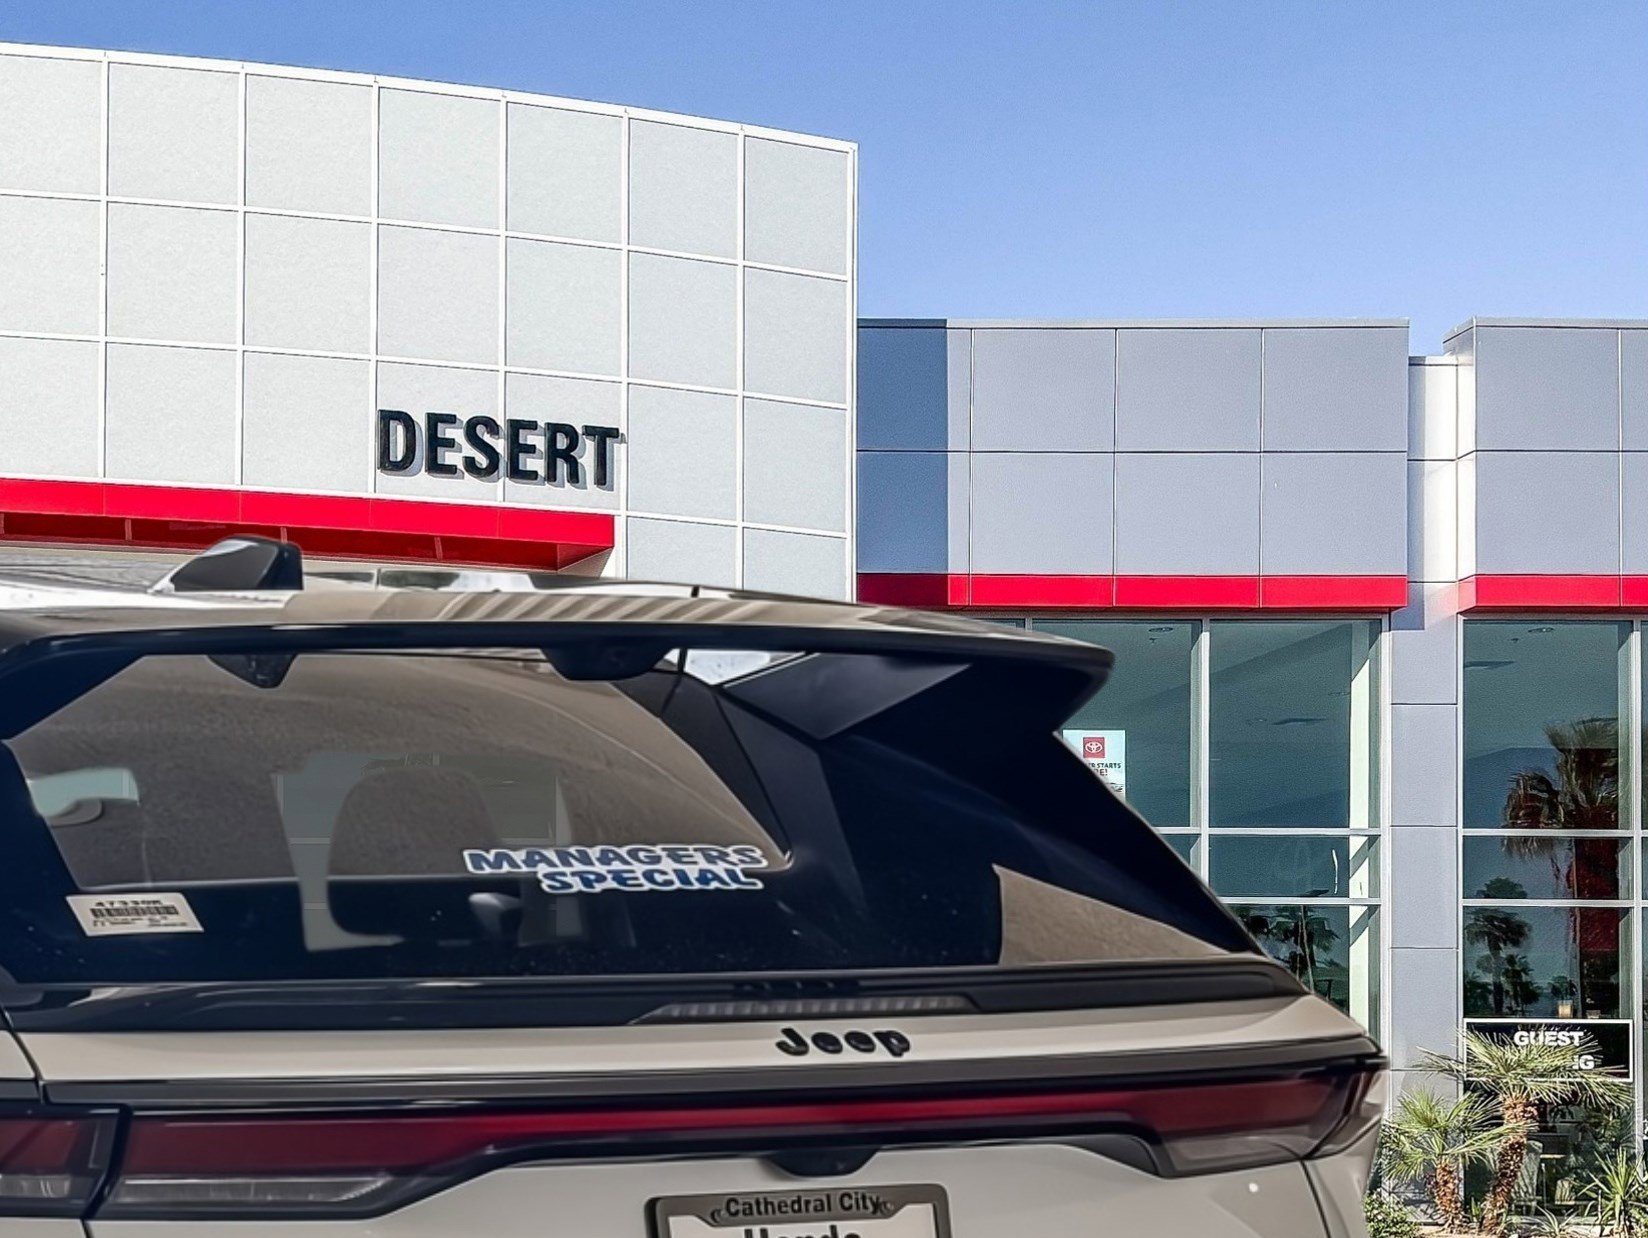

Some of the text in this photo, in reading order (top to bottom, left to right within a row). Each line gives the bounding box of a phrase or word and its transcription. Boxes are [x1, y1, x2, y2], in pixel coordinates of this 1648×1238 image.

[377, 409, 620, 486] DESERT
[464, 845, 767, 872] MANAGERS
[539, 867, 763, 892] SPECIAL
[775, 1028, 911, 1058] Jeep
[1513, 1030, 1584, 1047] GUEST
[724, 1192, 881, 1218] Cathedral City
